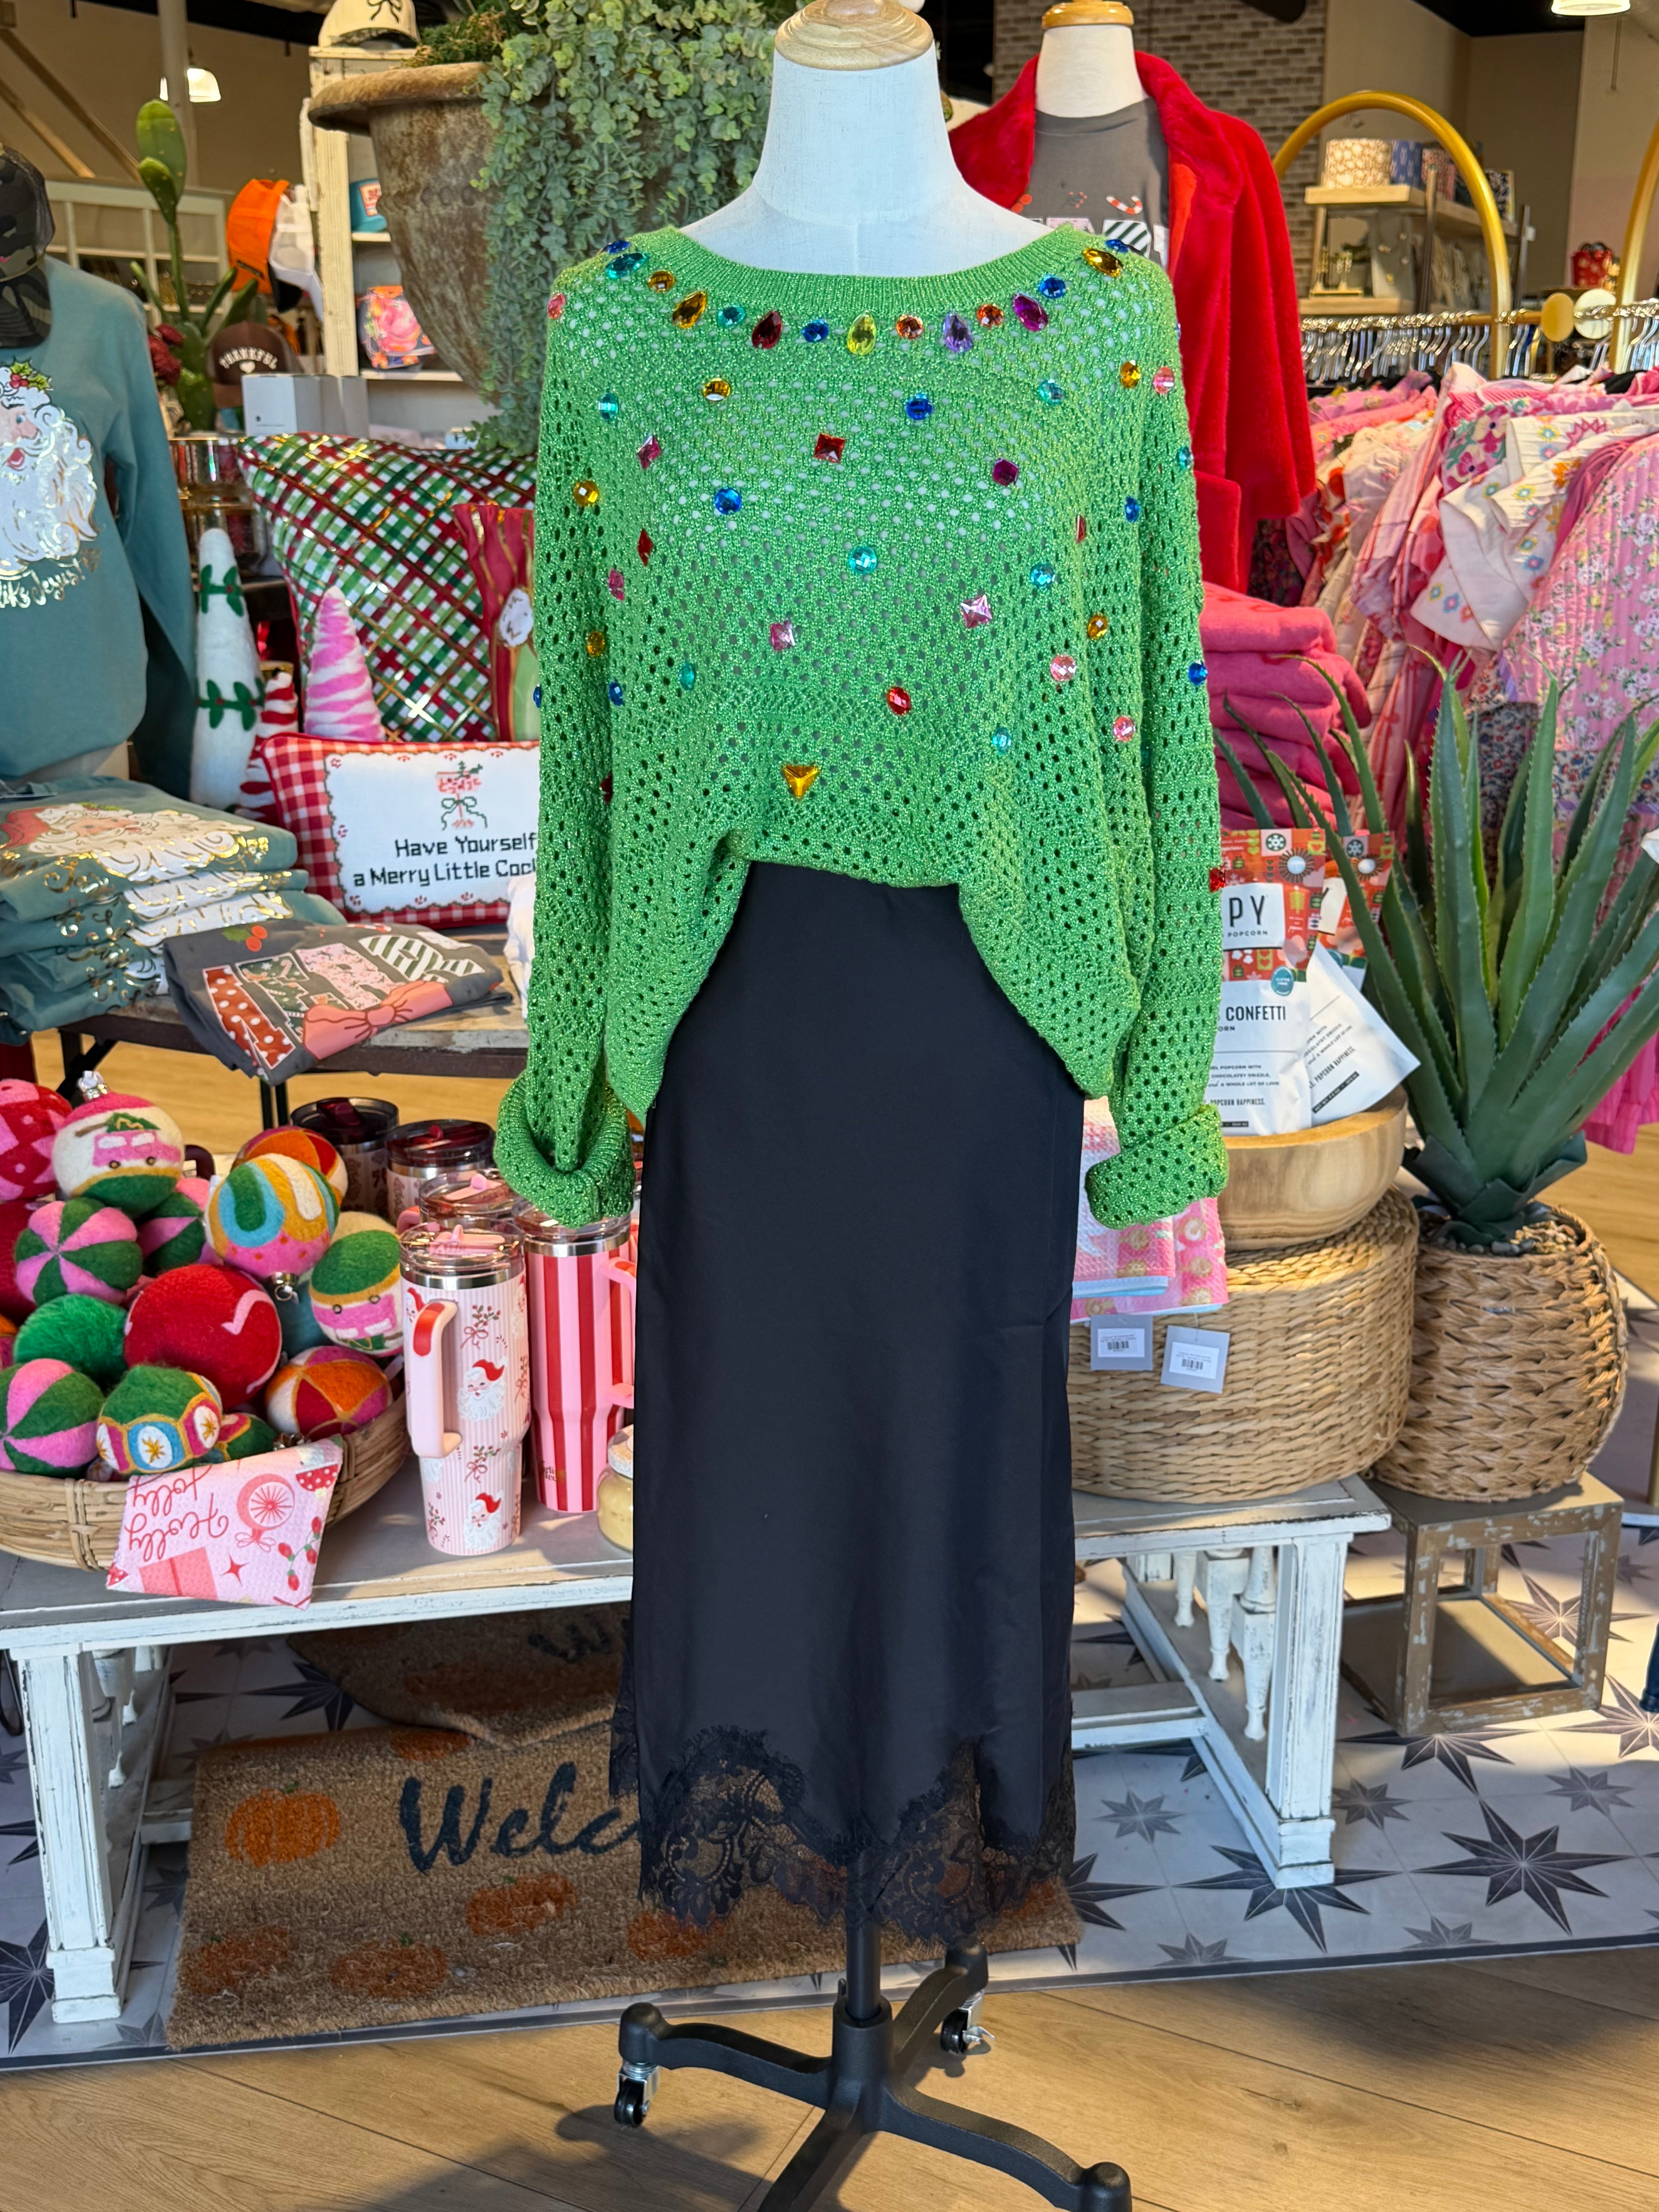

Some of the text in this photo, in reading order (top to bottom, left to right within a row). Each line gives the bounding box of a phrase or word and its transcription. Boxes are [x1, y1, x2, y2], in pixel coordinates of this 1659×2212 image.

[219, 347, 278, 369] THANKFUL
[395, 832, 537, 857] Have Yourself
[353, 873, 365, 887] a
[370, 867, 430, 886] Merry
[434, 861, 490, 881] Little
[1226, 1006, 1286, 1021] CONFETTI
[128, 1465, 213, 1516] Jolly
[124, 1492, 229, 1562] Holly
